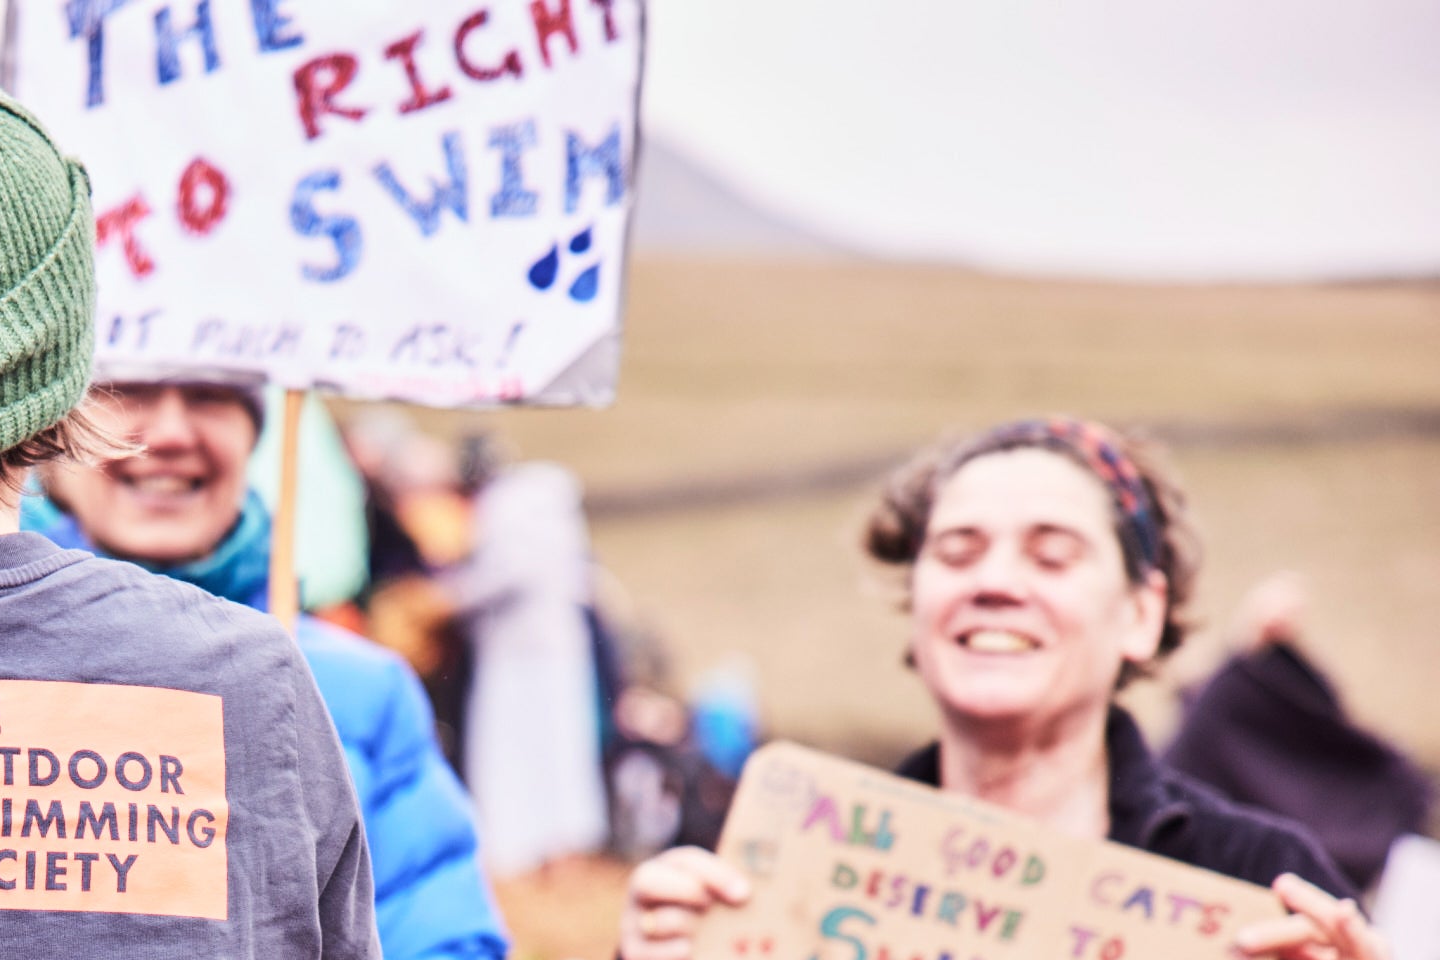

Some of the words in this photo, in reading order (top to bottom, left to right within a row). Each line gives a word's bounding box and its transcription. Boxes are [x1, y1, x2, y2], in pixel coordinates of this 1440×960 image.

[66, 0, 305, 109] THE
[293, 0, 618, 140] RIGHT
[96, 157, 231, 279] TO
[290, 122, 625, 283] SWIM
[800, 795, 897, 853] ALL
[942, 825, 1047, 888] GOOD
[1091, 872, 1230, 937] CATS
[831, 862, 1024, 941] DESERVE
